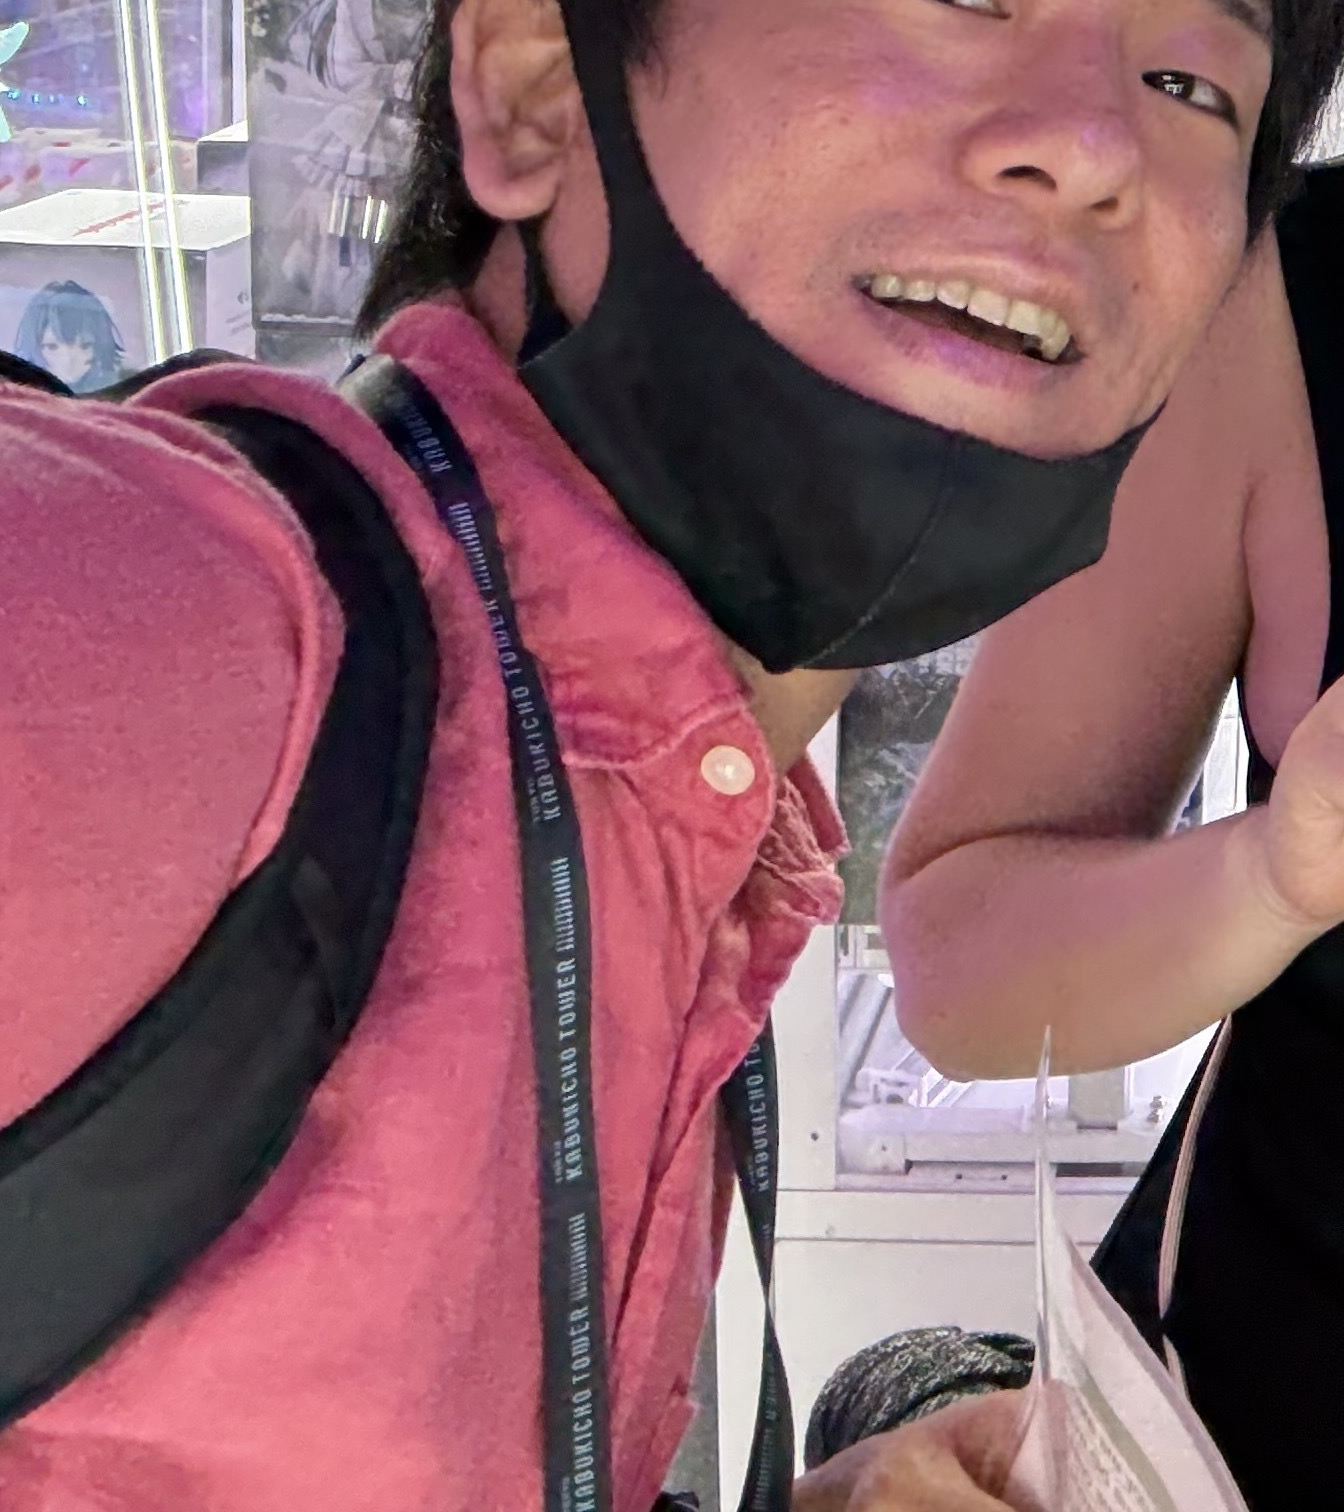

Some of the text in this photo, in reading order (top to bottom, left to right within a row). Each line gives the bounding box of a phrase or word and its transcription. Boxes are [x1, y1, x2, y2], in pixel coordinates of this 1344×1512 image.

[486, 598, 562, 821] KABUKICHO TOWER
[557, 958, 584, 1181] KABUKICHO TOWER
[746, 1072, 770, 1192] KABUKICHO
[569, 1307, 596, 1512] KABUKICHO TOWER
